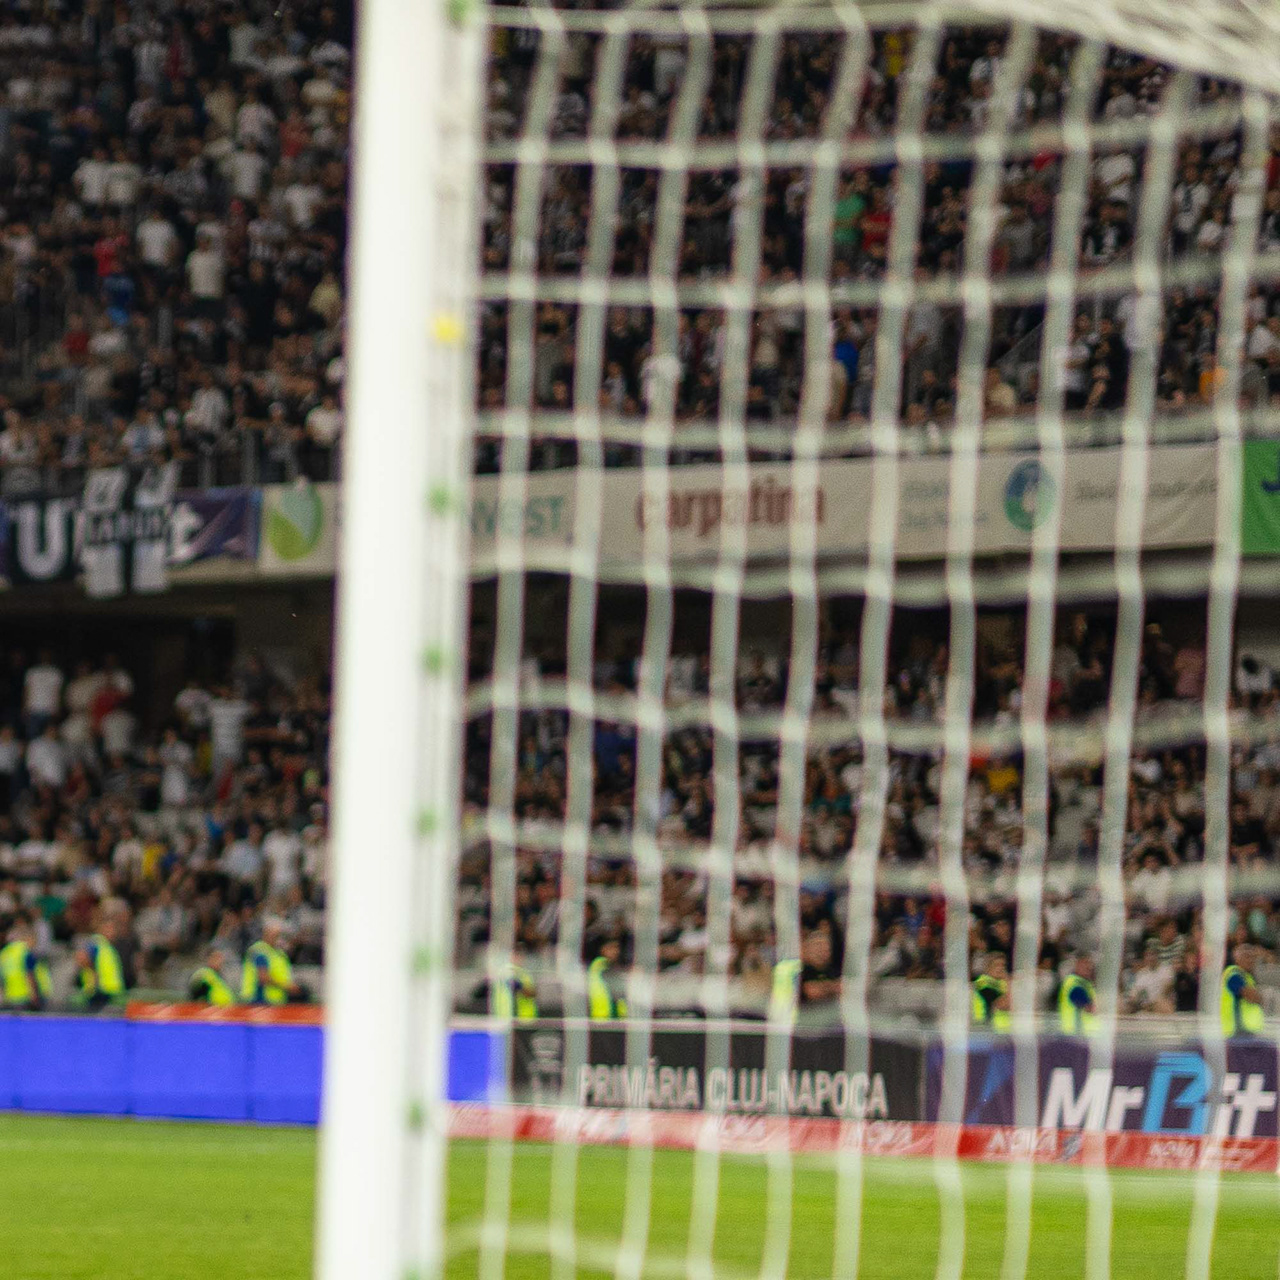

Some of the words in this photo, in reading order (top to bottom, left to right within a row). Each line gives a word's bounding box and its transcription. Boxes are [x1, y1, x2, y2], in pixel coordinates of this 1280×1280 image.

[636, 473, 825, 537] arptin
[705, 1065, 889, 1118] CLUJ-NAPOCA
[1040, 1052, 1276, 1140] MrBit
